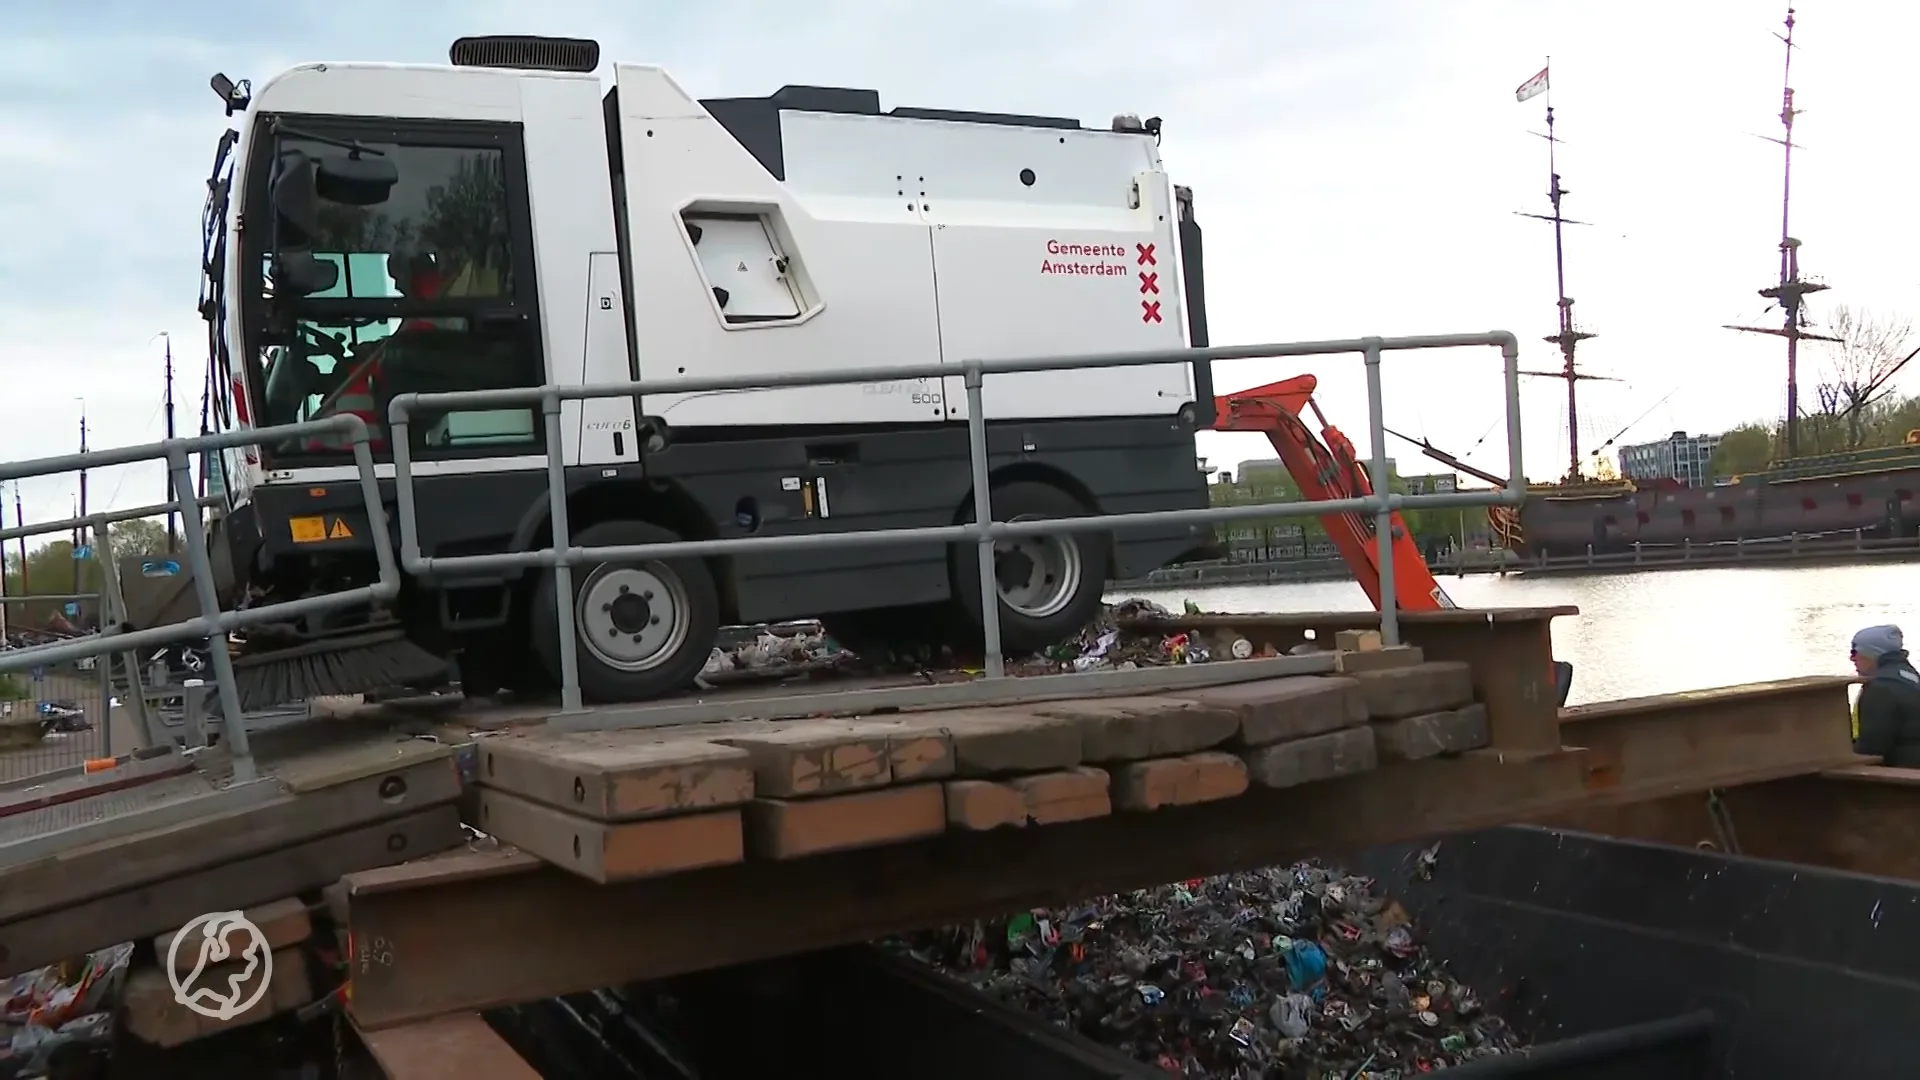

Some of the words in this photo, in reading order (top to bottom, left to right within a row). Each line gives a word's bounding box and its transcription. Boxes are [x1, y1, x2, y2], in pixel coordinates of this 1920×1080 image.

[1047, 239, 1125, 256] Gemeente
[1041, 259, 1127, 276] Amsterdam
[912, 393, 941, 404] 500
